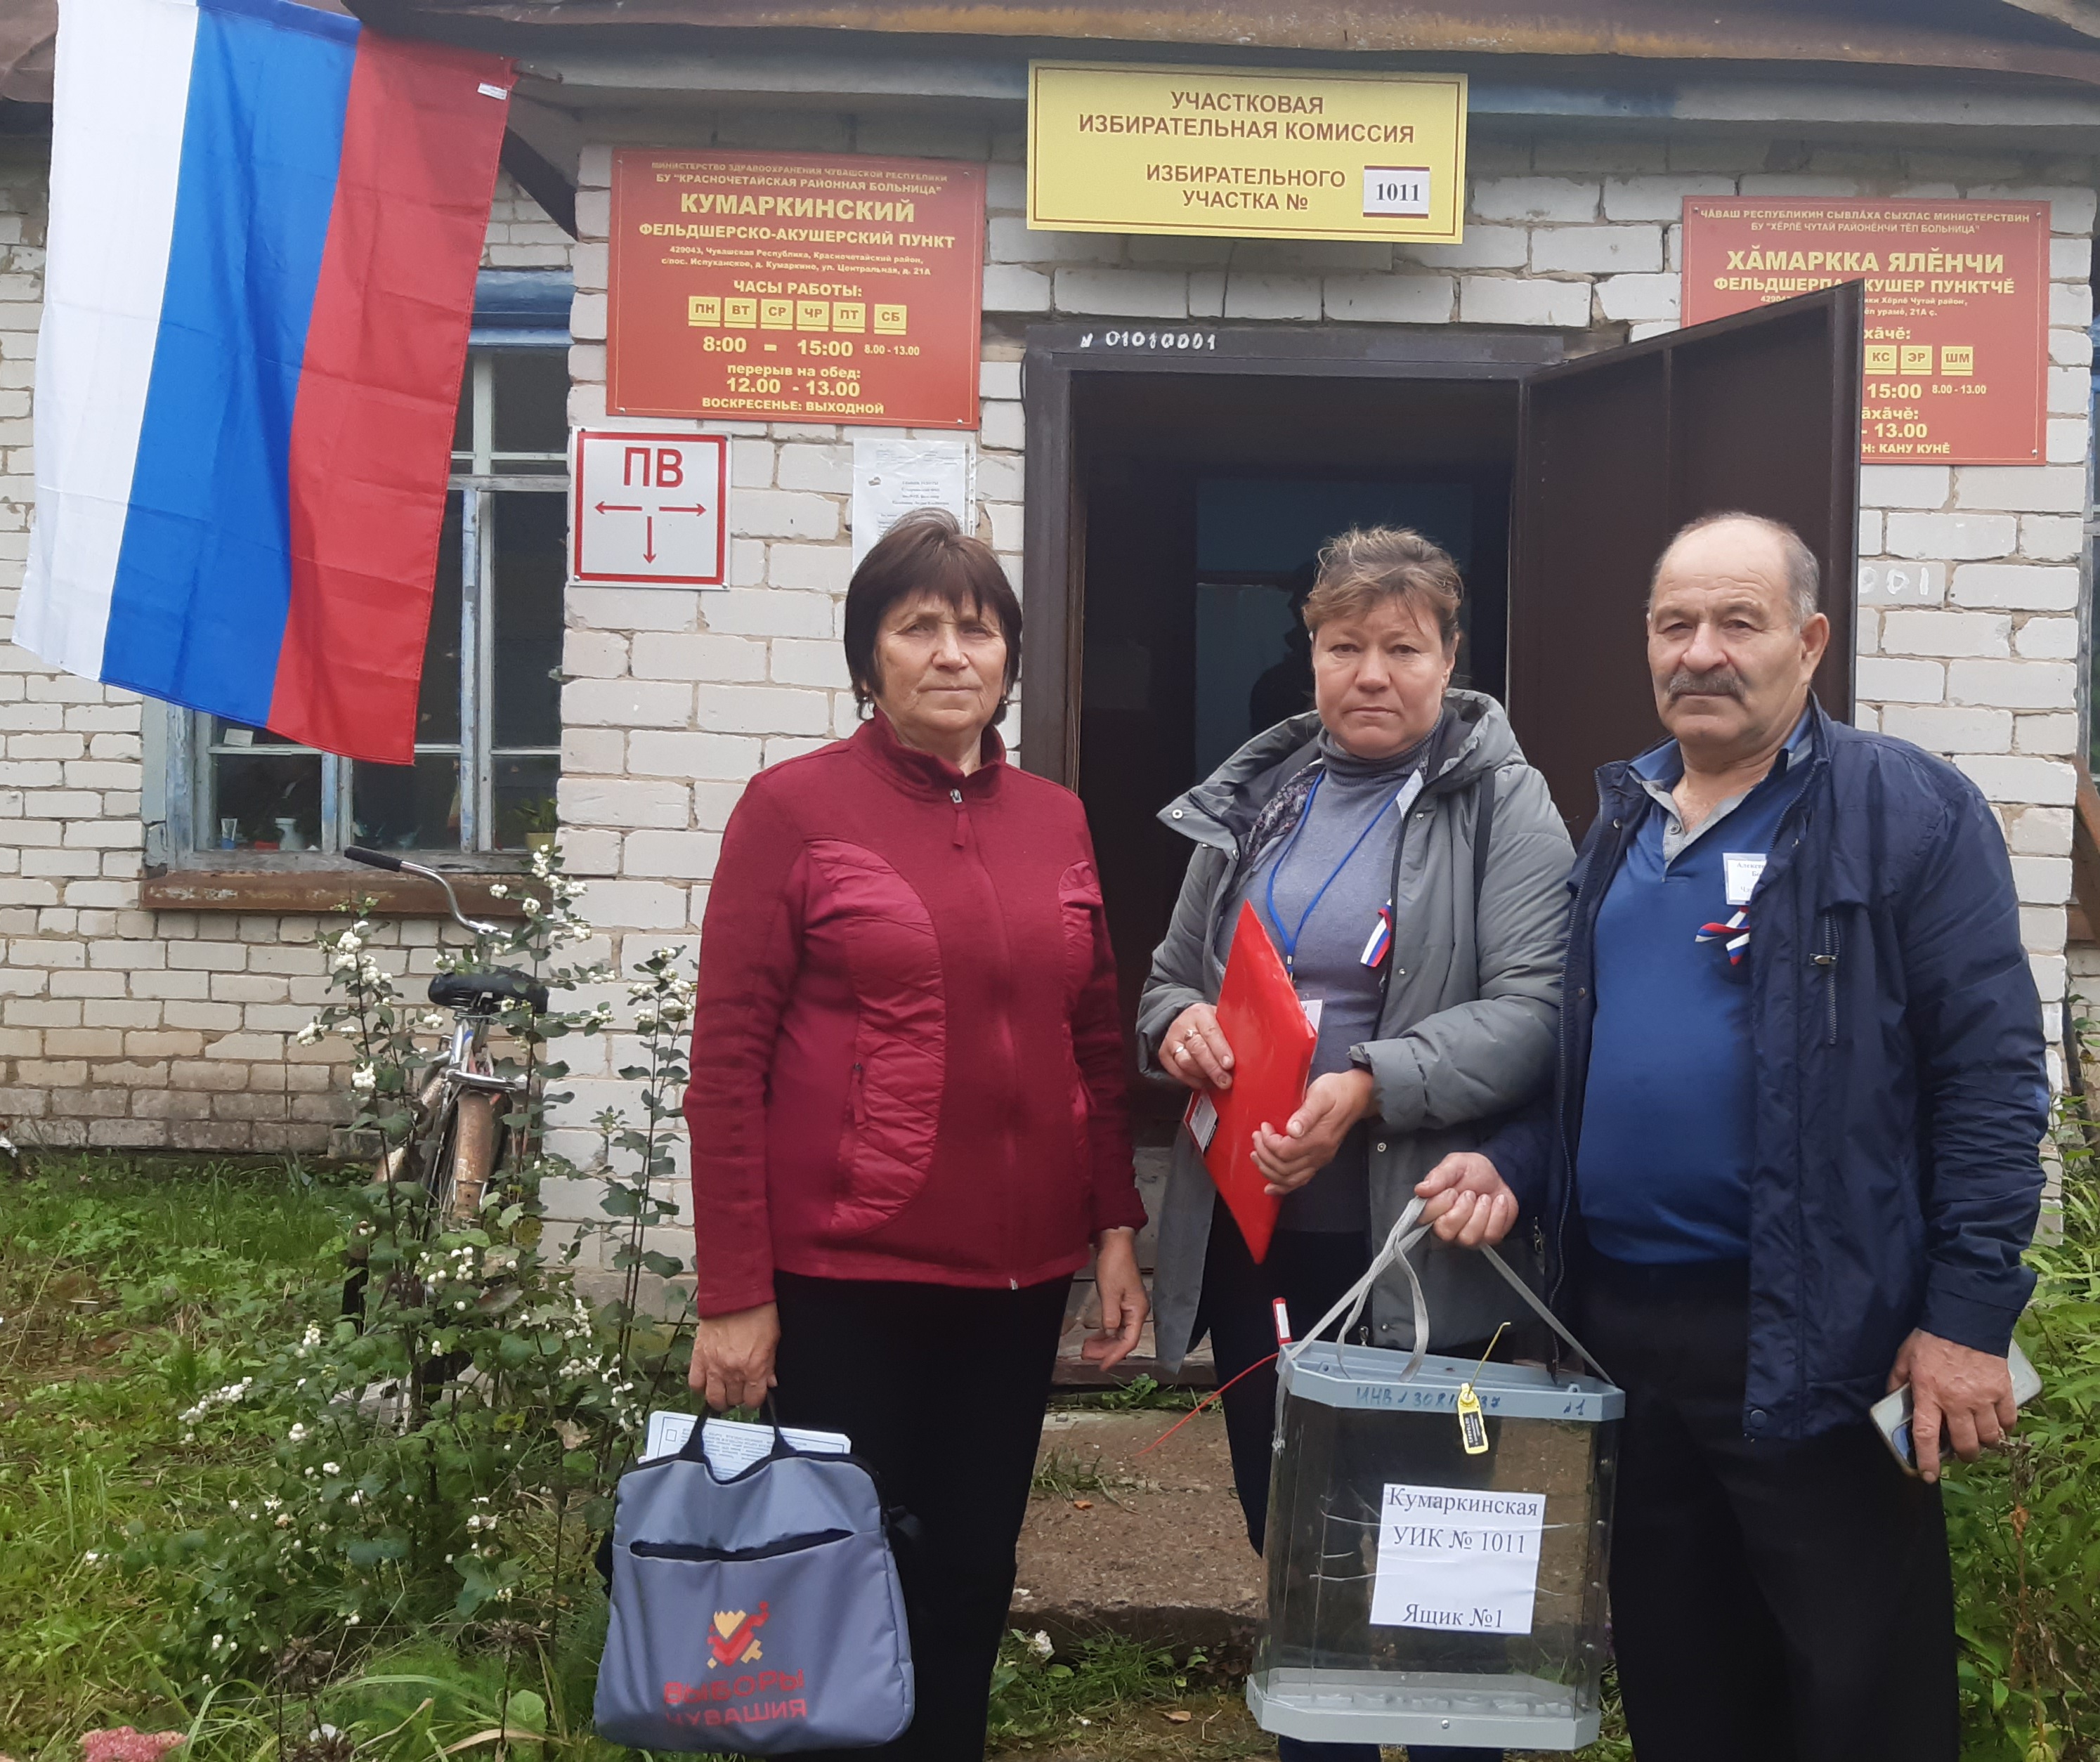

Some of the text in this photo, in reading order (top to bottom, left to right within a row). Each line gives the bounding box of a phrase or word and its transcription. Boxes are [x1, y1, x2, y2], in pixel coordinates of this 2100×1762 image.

[1170, 91, 1324, 115] УЧАСТКОВАЯ
[1078, 114, 1415, 143] ИЗБИРАТЕЛЬНАЯ КОМИССИЯ
[651, 162, 726, 171] МИНИСТЕРСТВО
[729, 164, 822, 175] ЗДРАВООХРАНЕНИЯ
[885, 172, 948, 182] РЕСПУБЛИКИ
[656, 174, 670, 183] БУ
[800, 178, 866, 190] РАЙОННАЯ
[1146, 164, 1346, 188] ИЗБИРАТЕЛЬНОГО
[1182, 189, 1309, 211] УЧАСТКА №
[1376, 182, 1420, 202] 1011
[681, 192, 915, 223] КУМАРКИНСКИЙ
[1743, 209, 1824, 219] РЕСПУБЛИКИН
[1933, 212, 2030, 223] МИНИСТЕРСТВИН
[639, 223, 956, 249] ФЕЛЬДШЕРСКО-АКУШЕРСКИЙ ПУНКТ
[1751, 222, 1764, 231] БУ
[1804, 221, 1836, 231] ЧУТАЙ
[705, 247, 754, 256] Чувашская
[814, 251, 892, 262] Красночетайский
[733, 280, 863, 297] ЧАСЫ РАБОТЫ:
[1865, 278, 1924, 292] КУШЕР
[695, 304, 900, 322] ПН ВТ СР ЧР ПТ СБ
[703, 336, 747, 353] 8:00
[797, 339, 853, 357] 15:00
[864, 344, 885, 355] 8.00
[894, 345, 920, 356] 13.00
[1872, 352, 1970, 363] КС ЭР ШМ
[727, 365, 861, 379] перерыв на обед:
[726, 377, 781, 393] 12.00
[806, 380, 861, 397] 13.00
[1867, 383, 1922, 399] 15:00
[1931, 385, 1952, 394] 8.00
[1960, 385, 1987, 394] 13.00
[702, 397, 885, 415] ВОСКРЕСЕНЬЕ: ВЫХОДНОЙ
[1874, 423, 1927, 438] 13.00
[1879, 444, 1913, 453] КАНУ
[623, 447, 684, 488] ПВ
[1388, 1486, 1538, 1517] Кумаркинская
[1393, 1525, 1525, 1553] УИК № 1011
[1402, 1603, 1503, 1629] Ящик №1
[663, 1669, 804, 1704] ВЫБОРЫ
[665, 1698, 807, 1726] ЧУВАШИЯ
